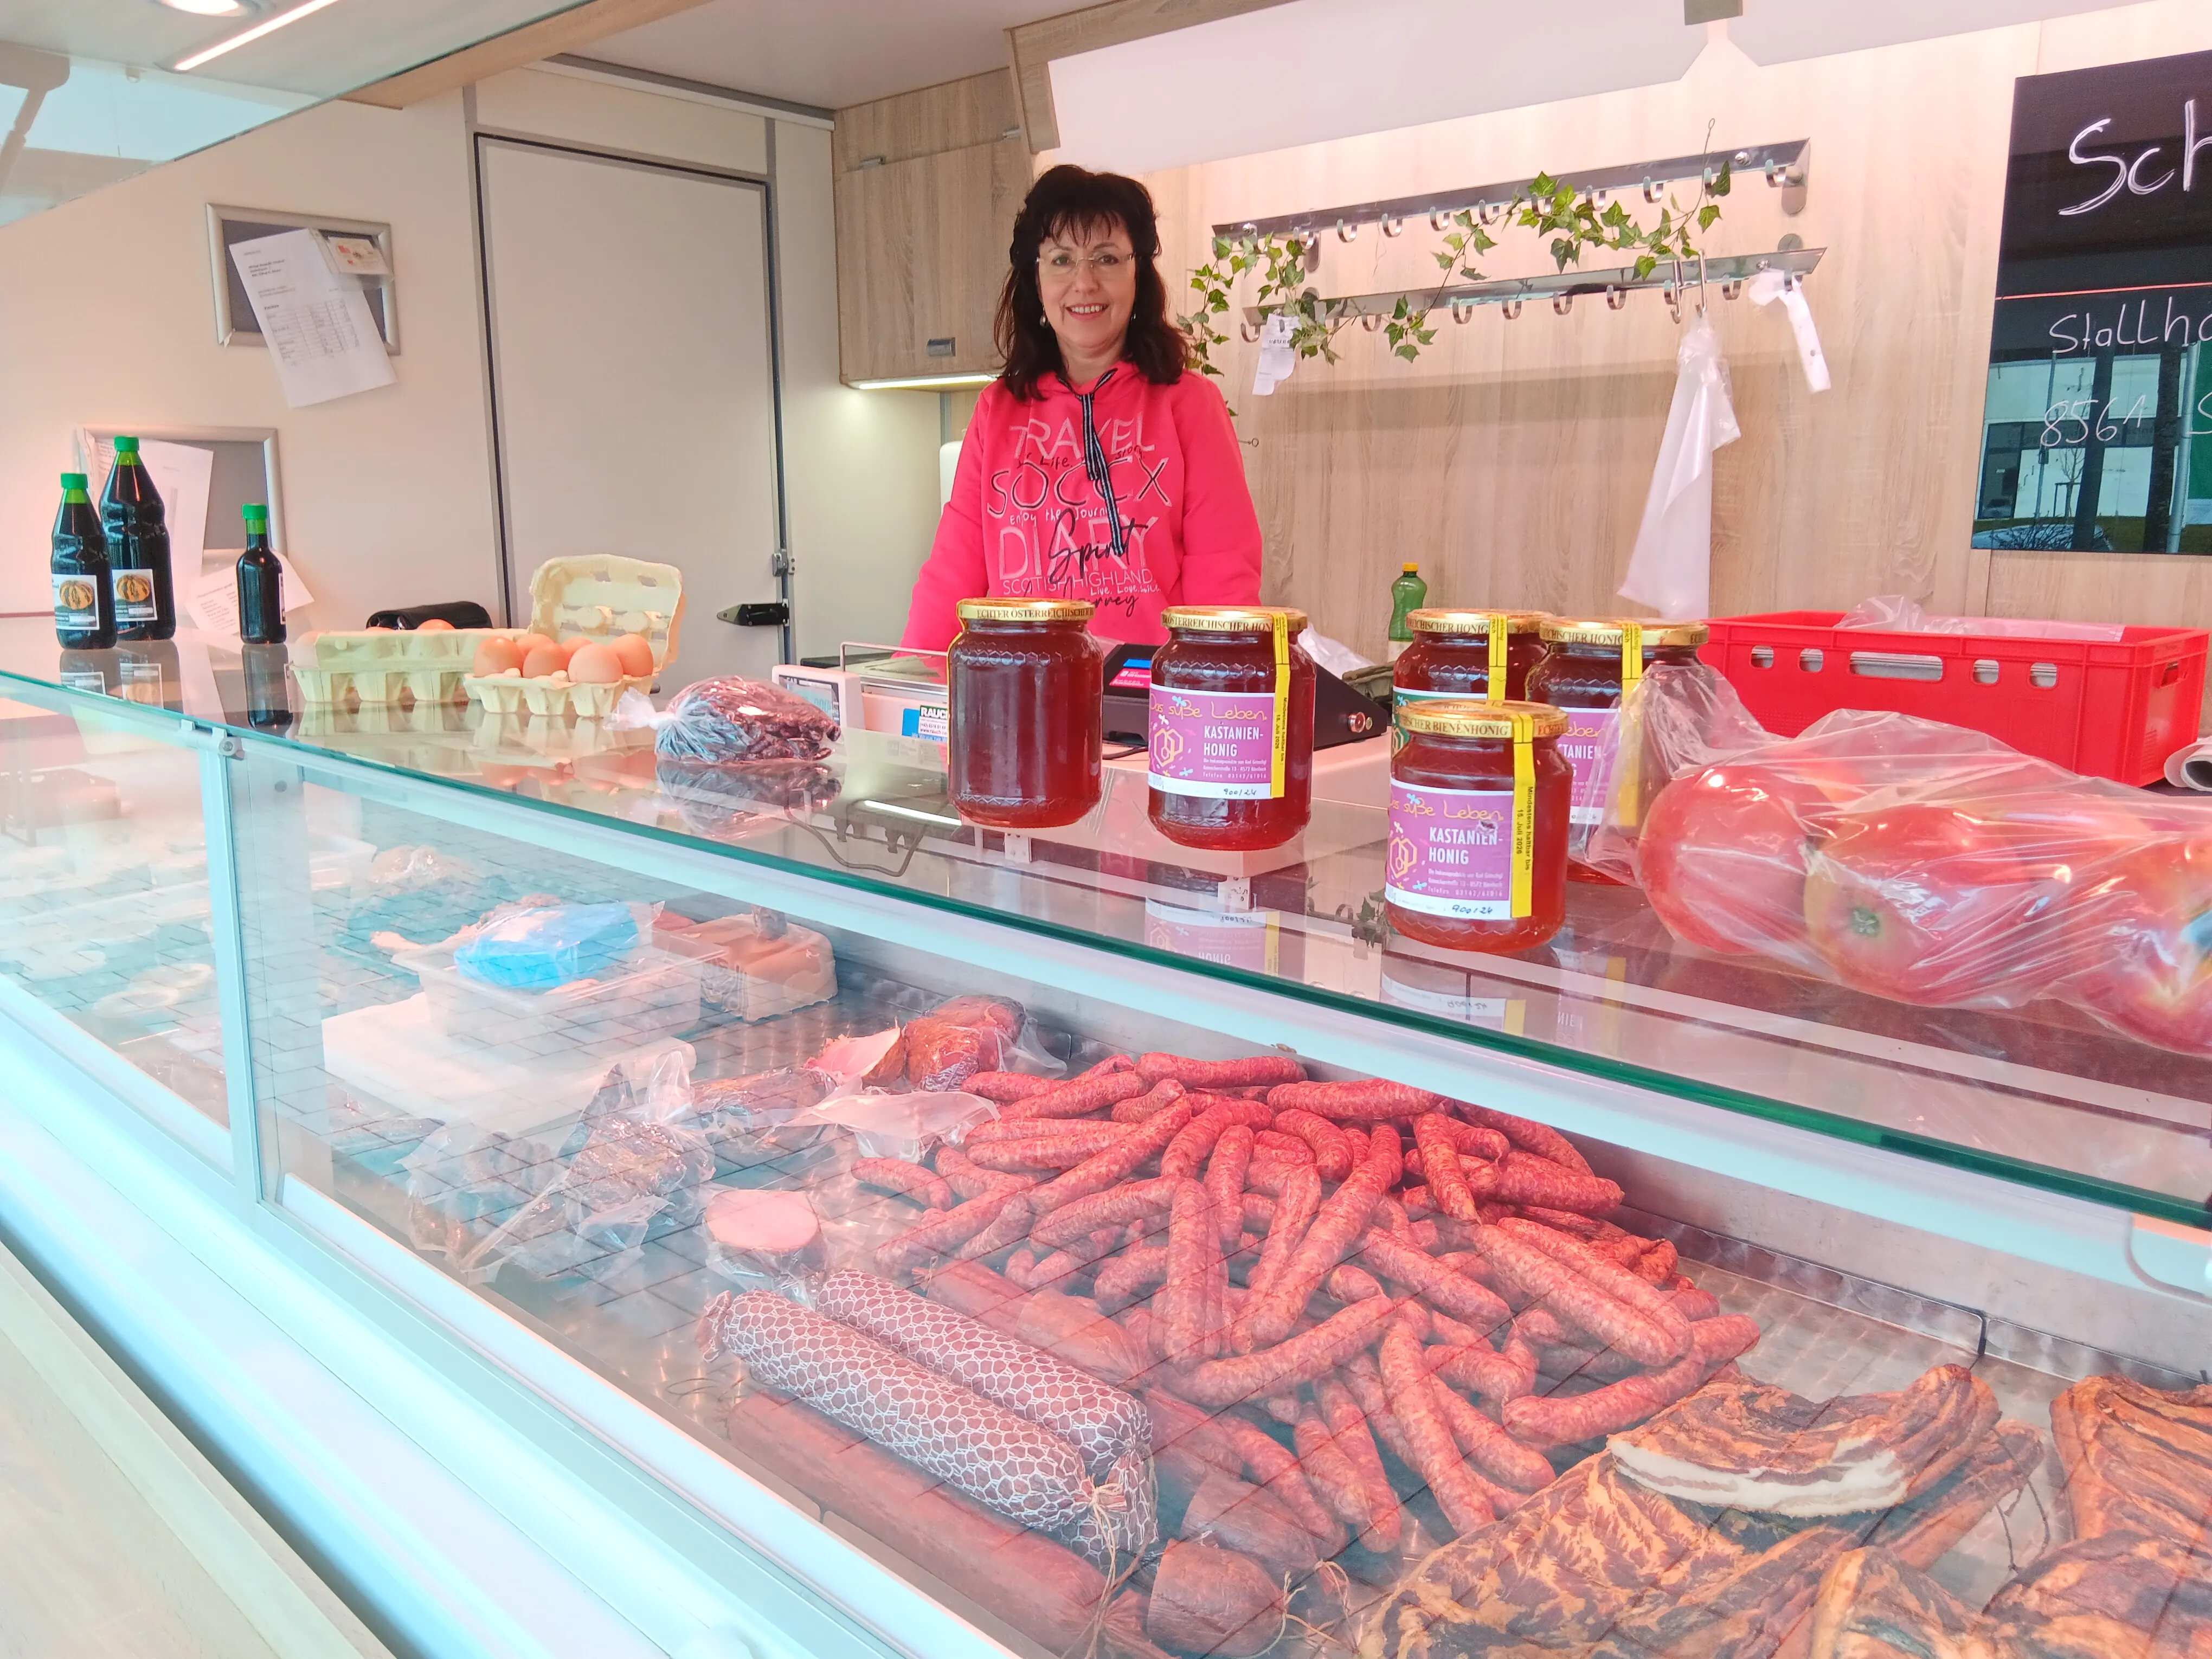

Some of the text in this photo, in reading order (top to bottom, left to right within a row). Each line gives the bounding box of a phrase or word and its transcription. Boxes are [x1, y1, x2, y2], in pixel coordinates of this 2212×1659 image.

[987, 456, 1173, 519] SOCCX
[1010, 509, 1037, 526] Enjoy
[999, 514, 1159, 580] DIARY
[1073, 568, 1153, 589] HIGHLAND
[977, 609, 1009, 619] ECHTER
[1204, 725, 1264, 740] KASTANIEN-
[1204, 743, 1238, 757] HONIG
[1429, 826, 1503, 845] KASTANIEN-
[1429, 846, 1469, 865] HONIG
